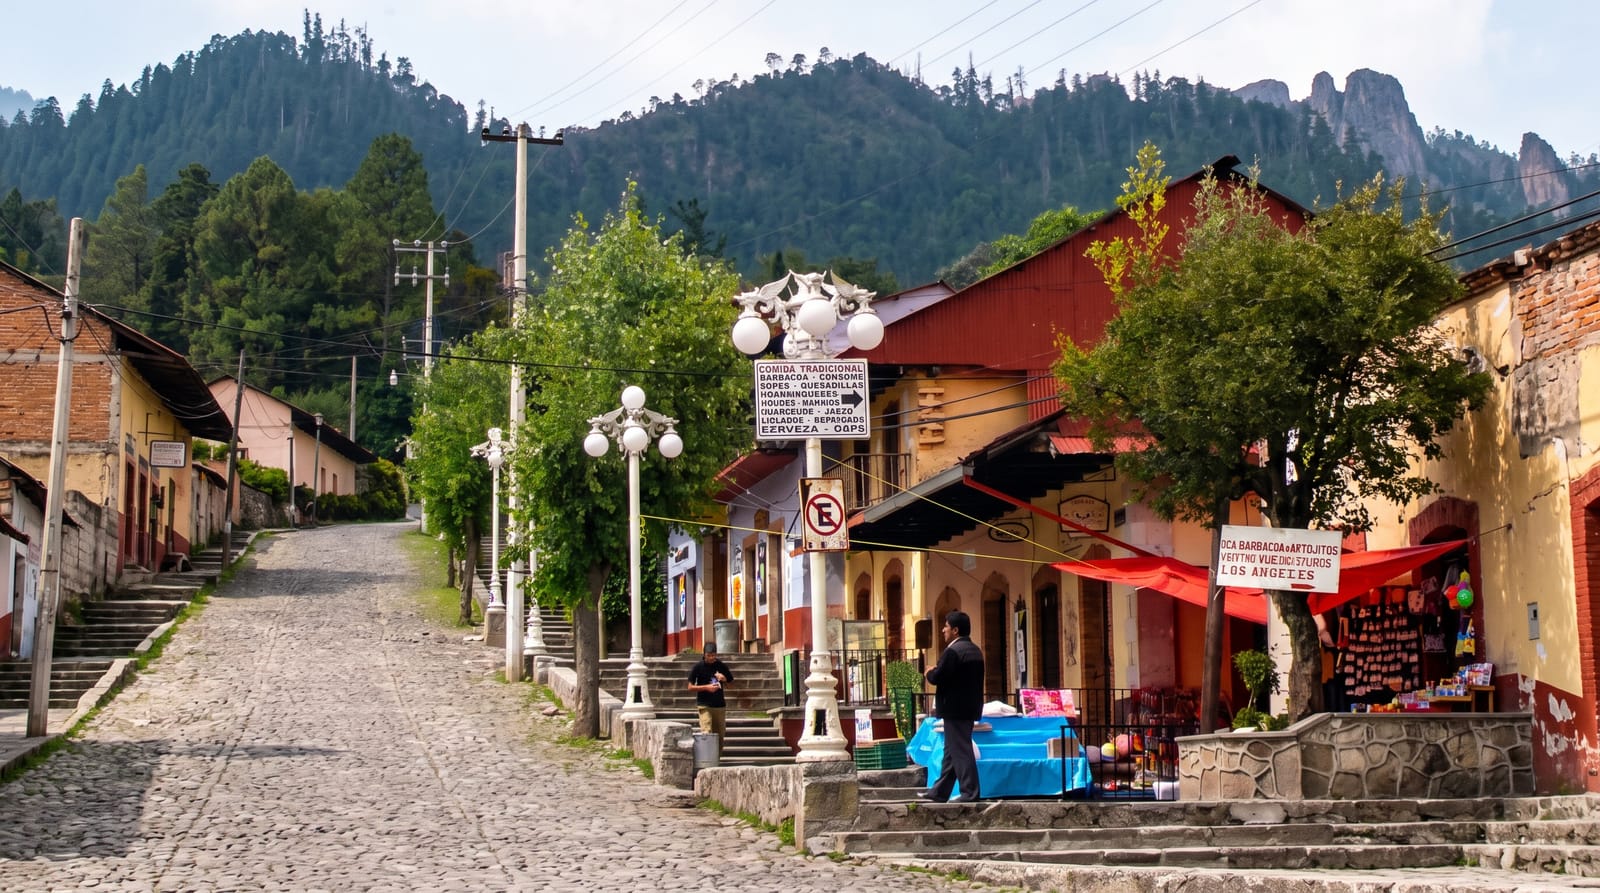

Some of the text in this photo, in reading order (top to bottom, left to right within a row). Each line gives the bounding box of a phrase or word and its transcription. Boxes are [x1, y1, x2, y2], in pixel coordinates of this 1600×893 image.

[759, 365, 796, 373] COMIDA
[816, 503, 832, 526] E
[1221, 564, 1246, 576] LOS
